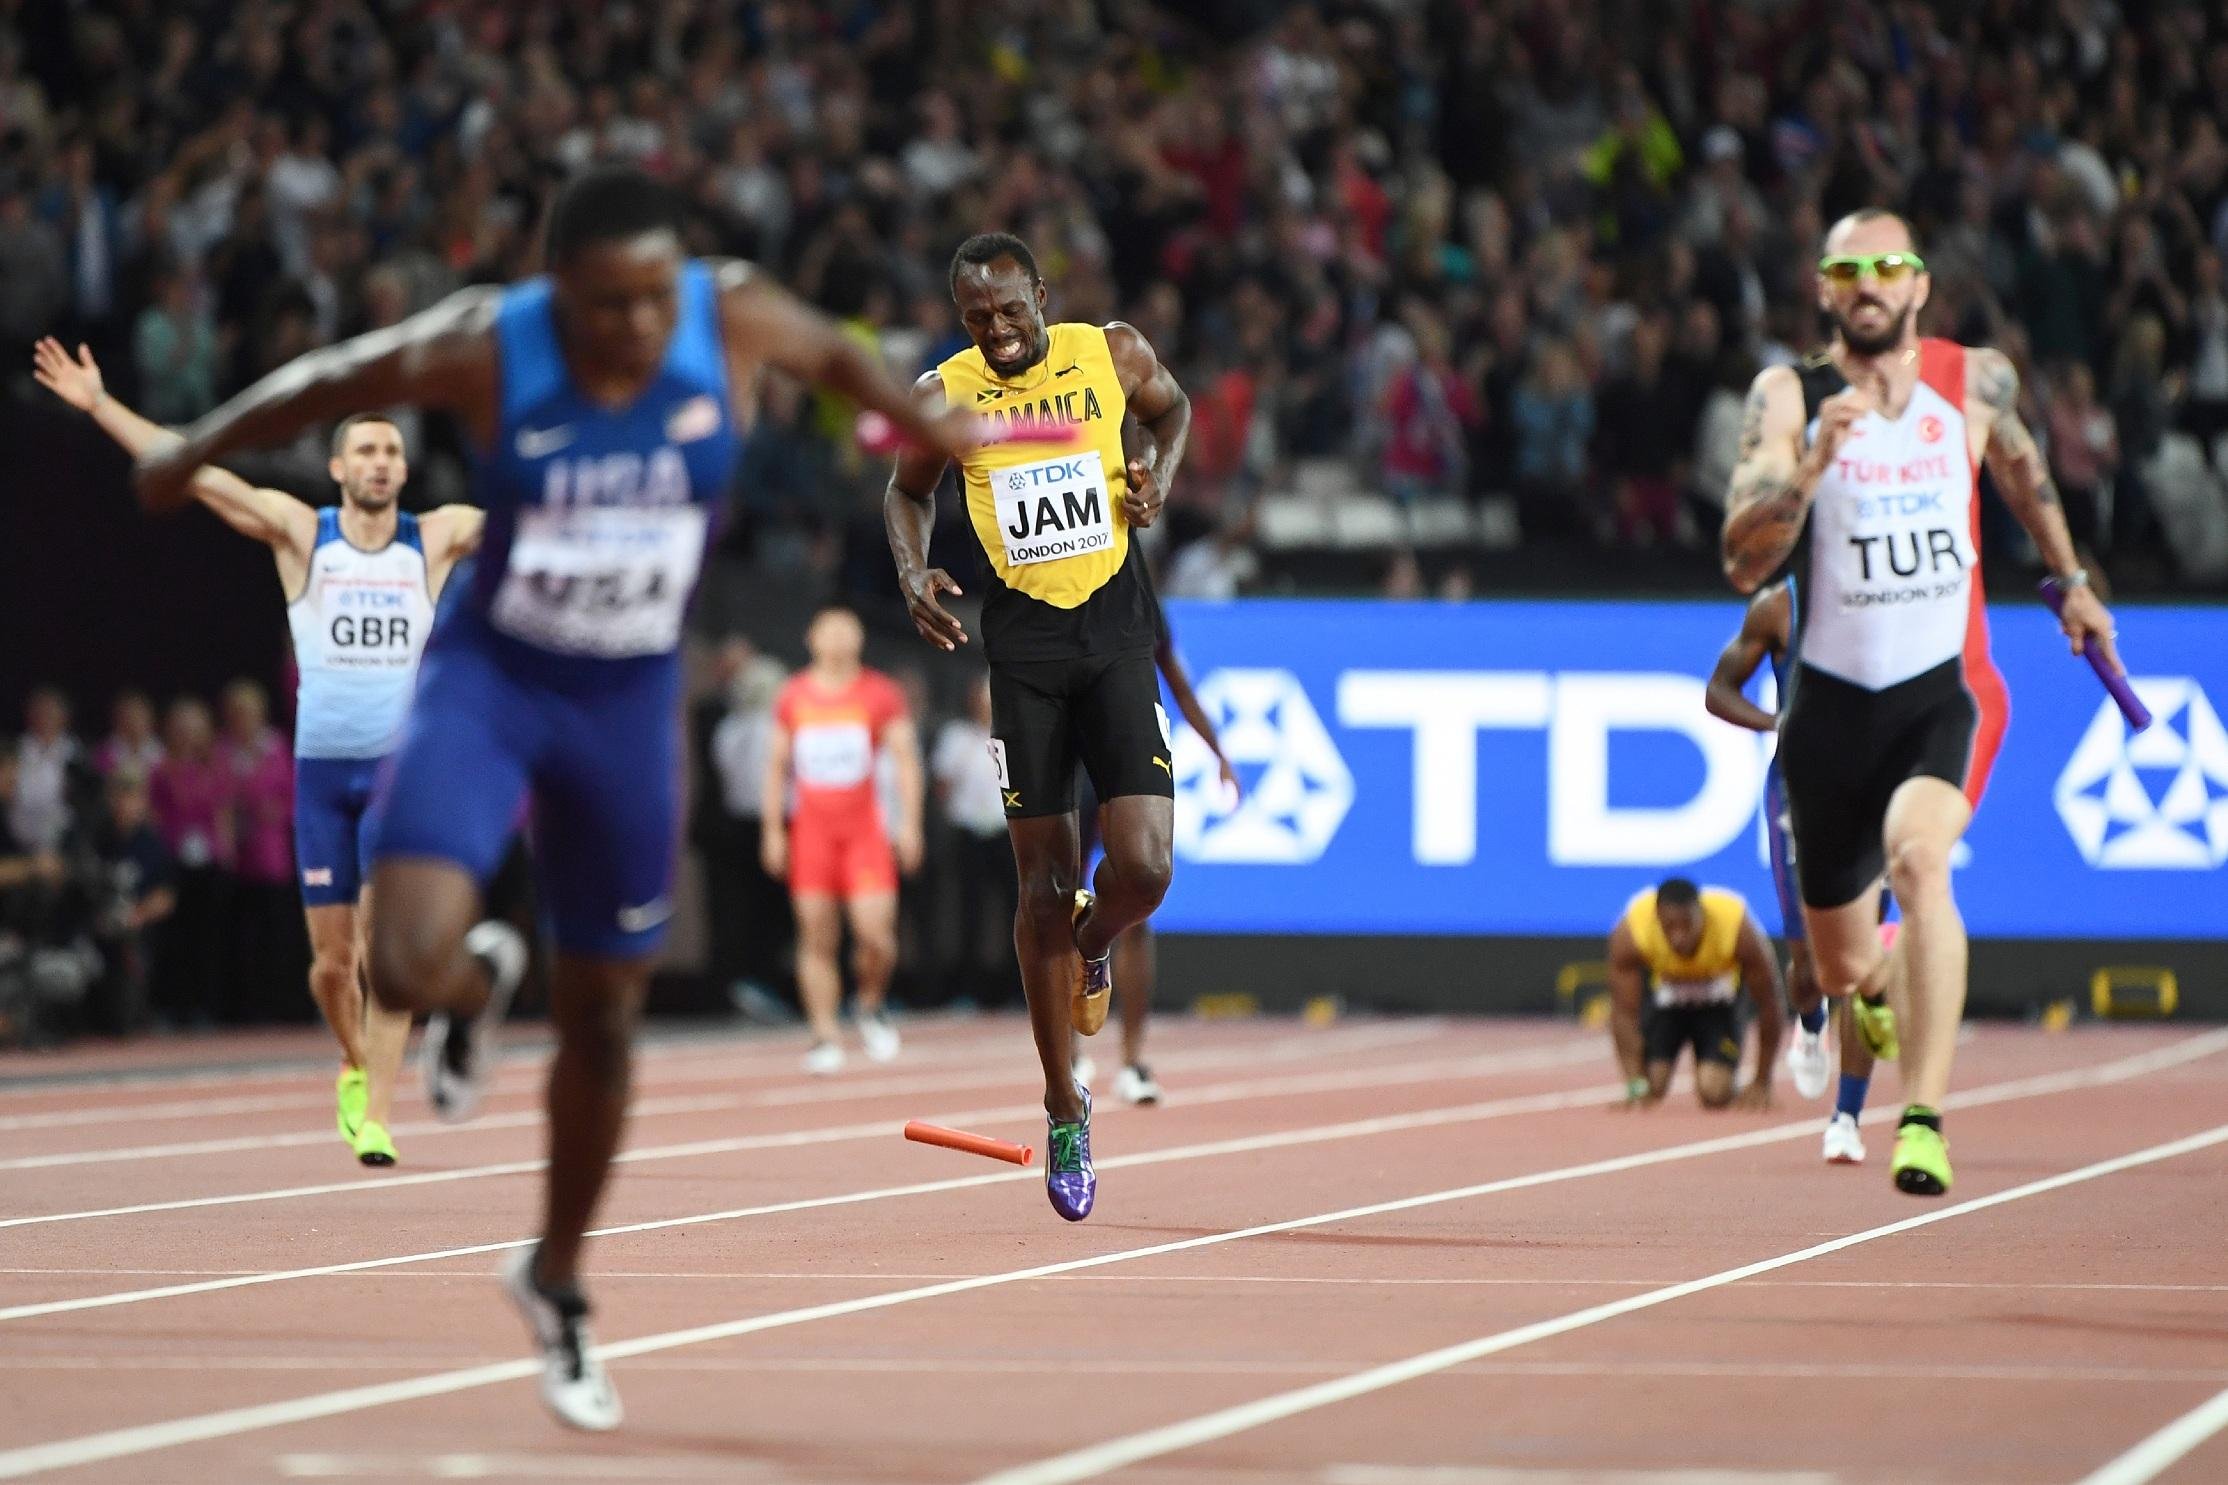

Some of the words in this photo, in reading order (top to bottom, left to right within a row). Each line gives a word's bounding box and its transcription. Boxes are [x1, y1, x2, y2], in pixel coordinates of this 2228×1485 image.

[1024, 460, 1085, 486] TDK
[1009, 487, 1101, 540] JAM
[1878, 491, 1944, 516] TDK
[1011, 541, 1075, 562] LONDON
[1078, 532, 1109, 549] 2017
[1849, 529, 1962, 579] TUR
[1842, 587, 1929, 606] LONDON
[331, 615, 409, 647] GBR
[1338, 670, 1971, 868] TD
